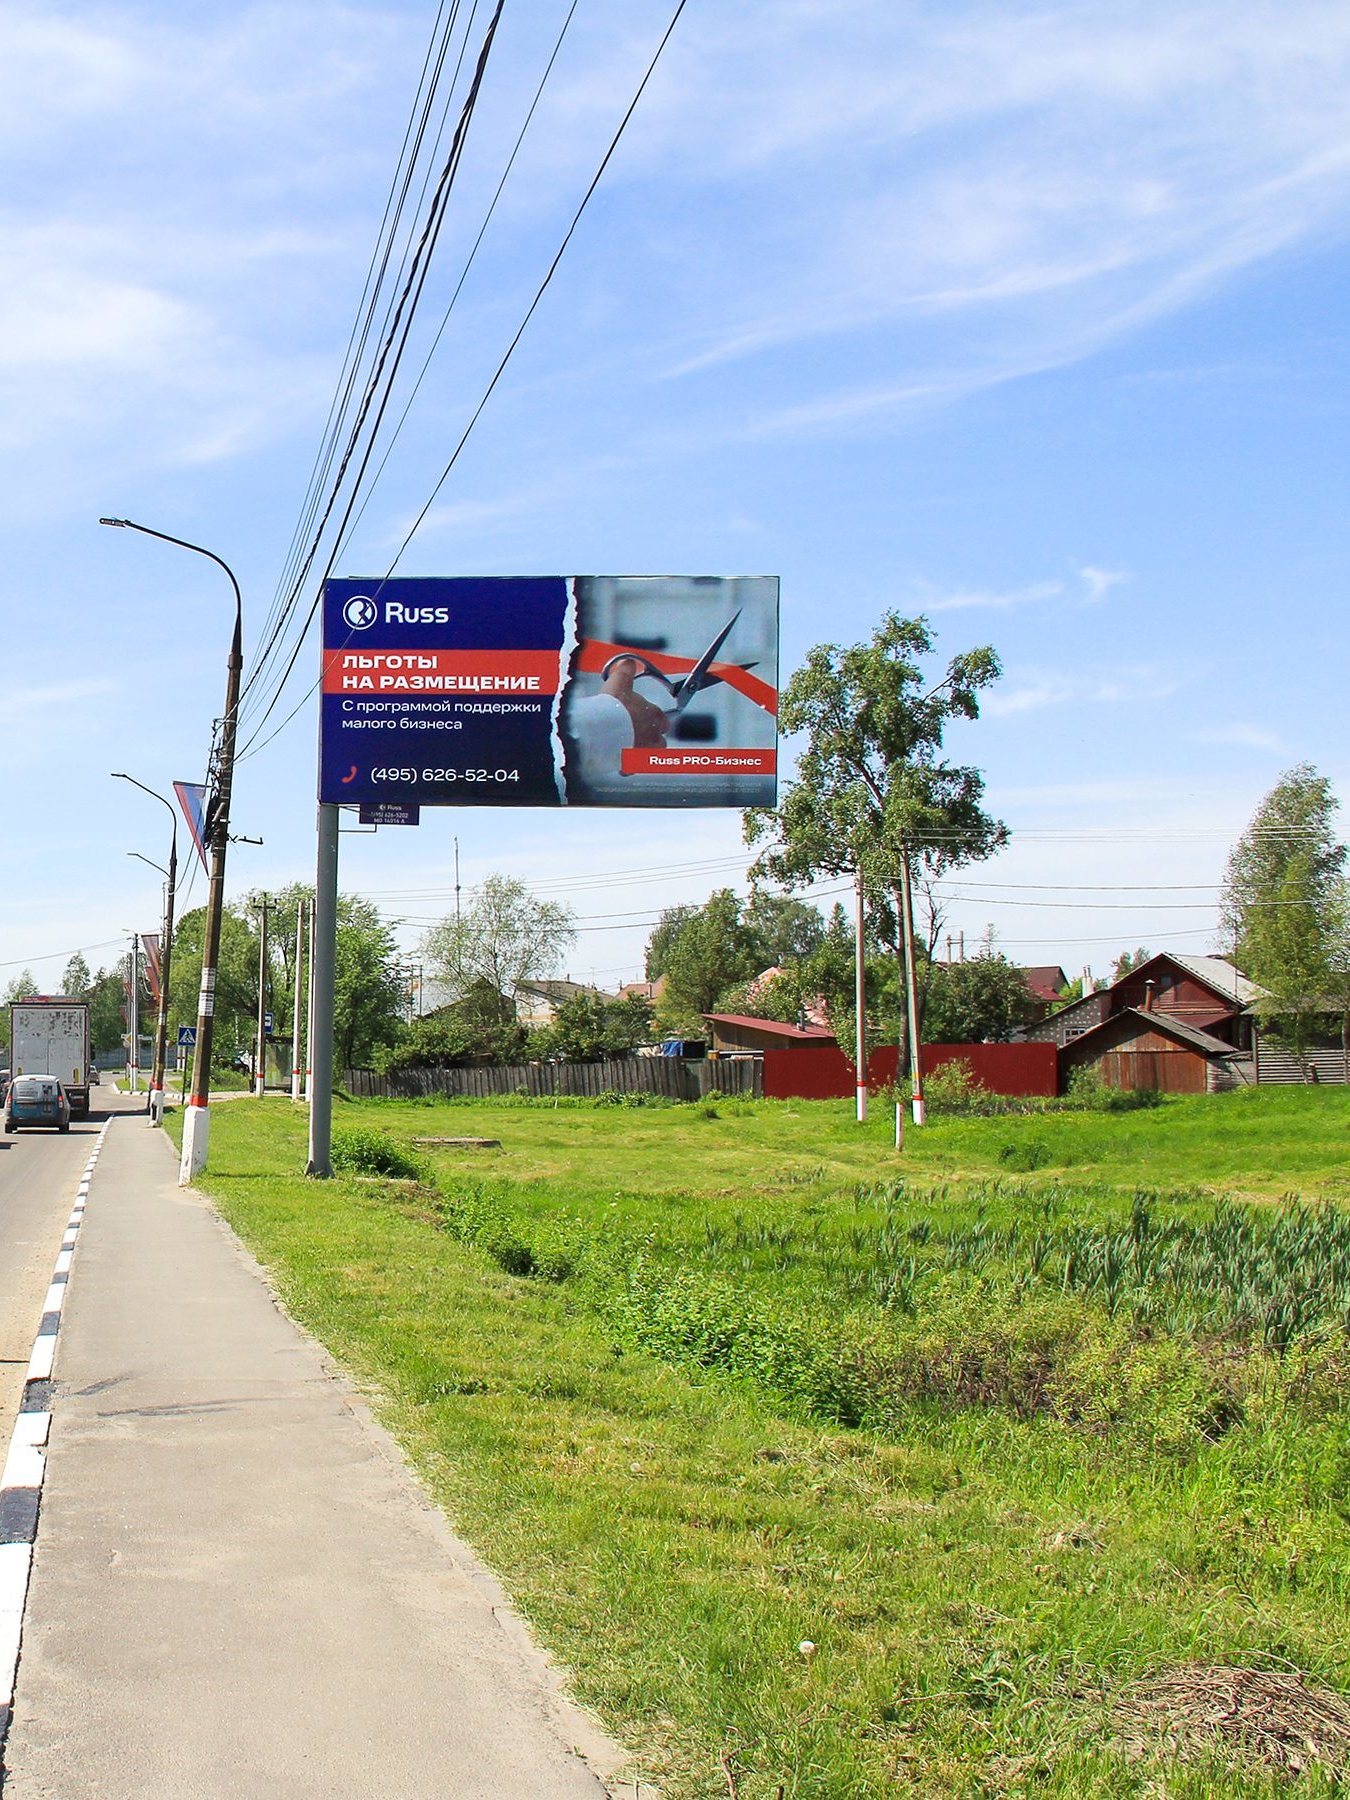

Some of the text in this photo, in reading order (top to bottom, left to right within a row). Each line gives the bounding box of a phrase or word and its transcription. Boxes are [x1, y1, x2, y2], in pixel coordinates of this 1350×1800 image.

[385, 602, 449, 624] Russ
[342, 655, 438, 669] ЛЬГОТЫ
[342, 675, 540, 692] НА РАЗМЕЩЕНИЕ
[342, 700, 541, 715] С программой поддержки
[342, 717, 463, 730] малого бизнеса
[649, 756, 762, 766] Russ PRO-Бизнес
[371, 767, 520, 784] (495) 626-52-04
